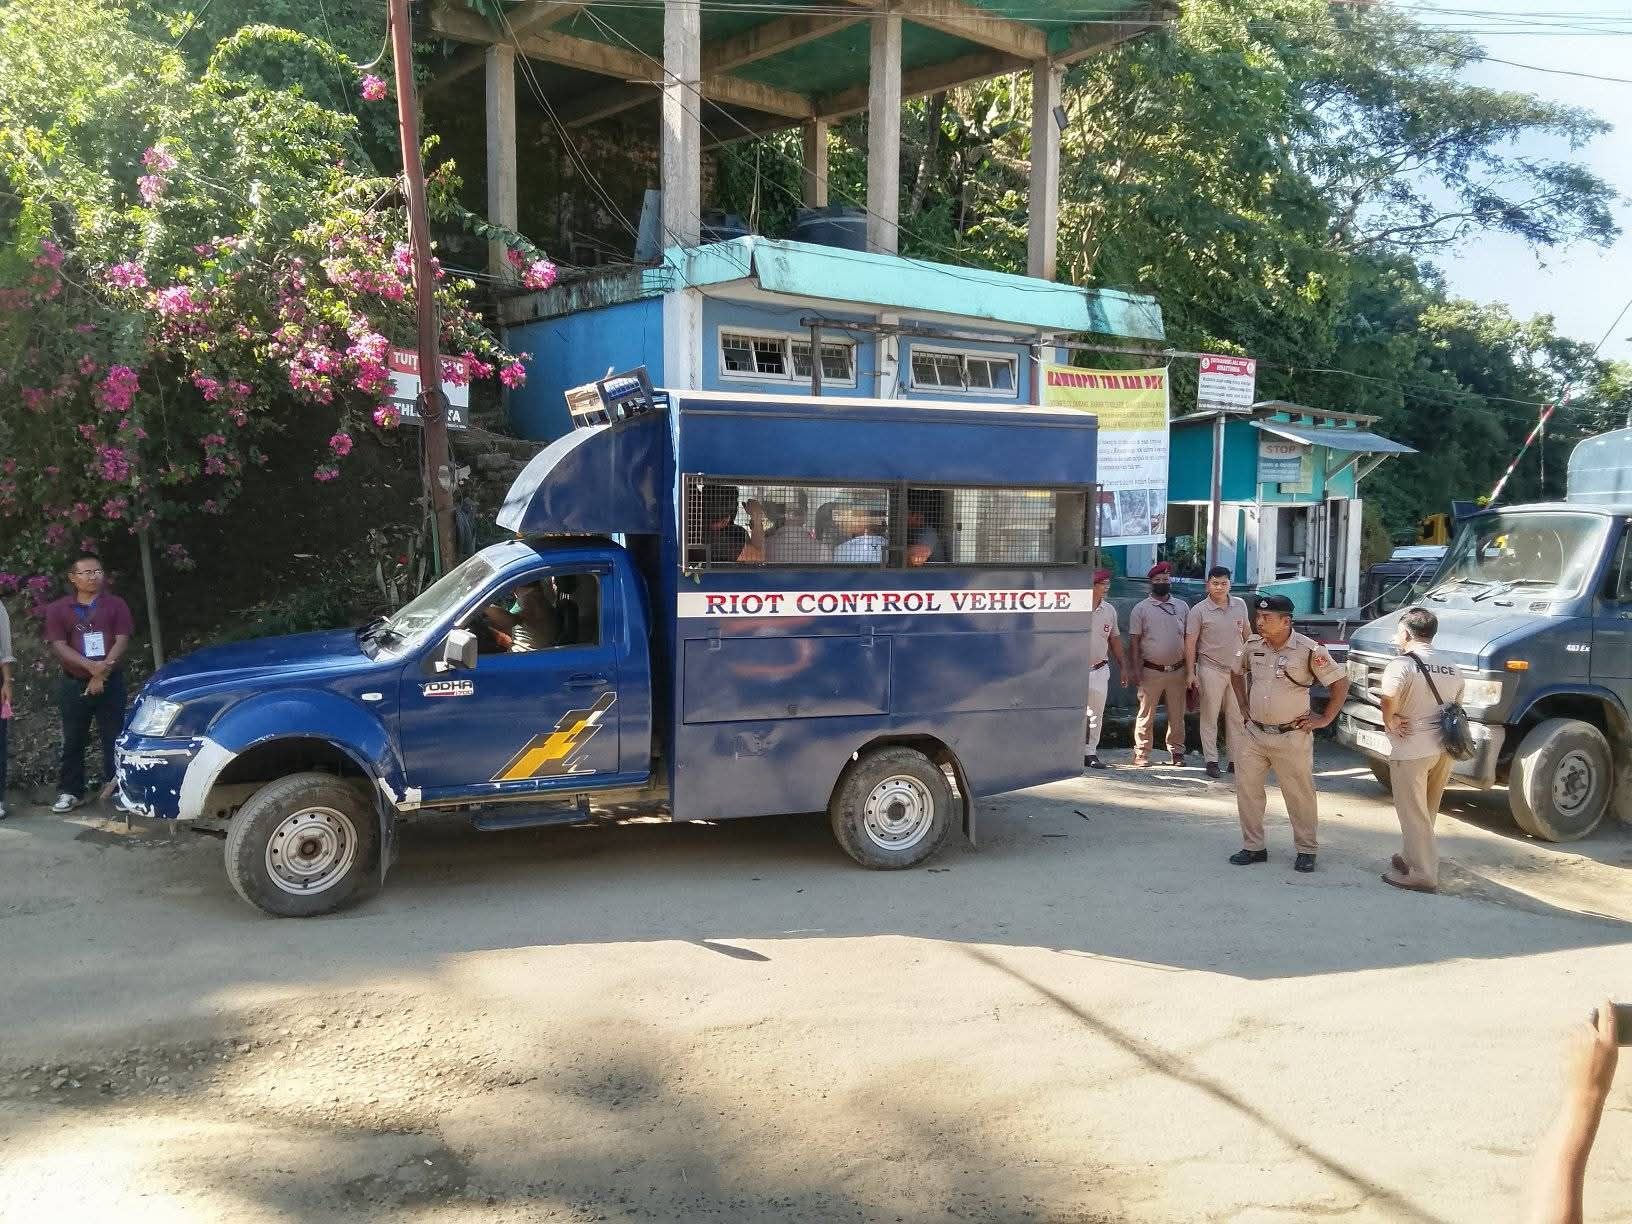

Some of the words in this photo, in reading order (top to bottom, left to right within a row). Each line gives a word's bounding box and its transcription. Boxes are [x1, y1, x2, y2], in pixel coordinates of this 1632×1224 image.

[1265, 444, 1296, 454] STOP
[706, 594, 784, 614] RIOT
[797, 593, 941, 613] CONTROL
[950, 592, 1071, 611] VEHICLE
